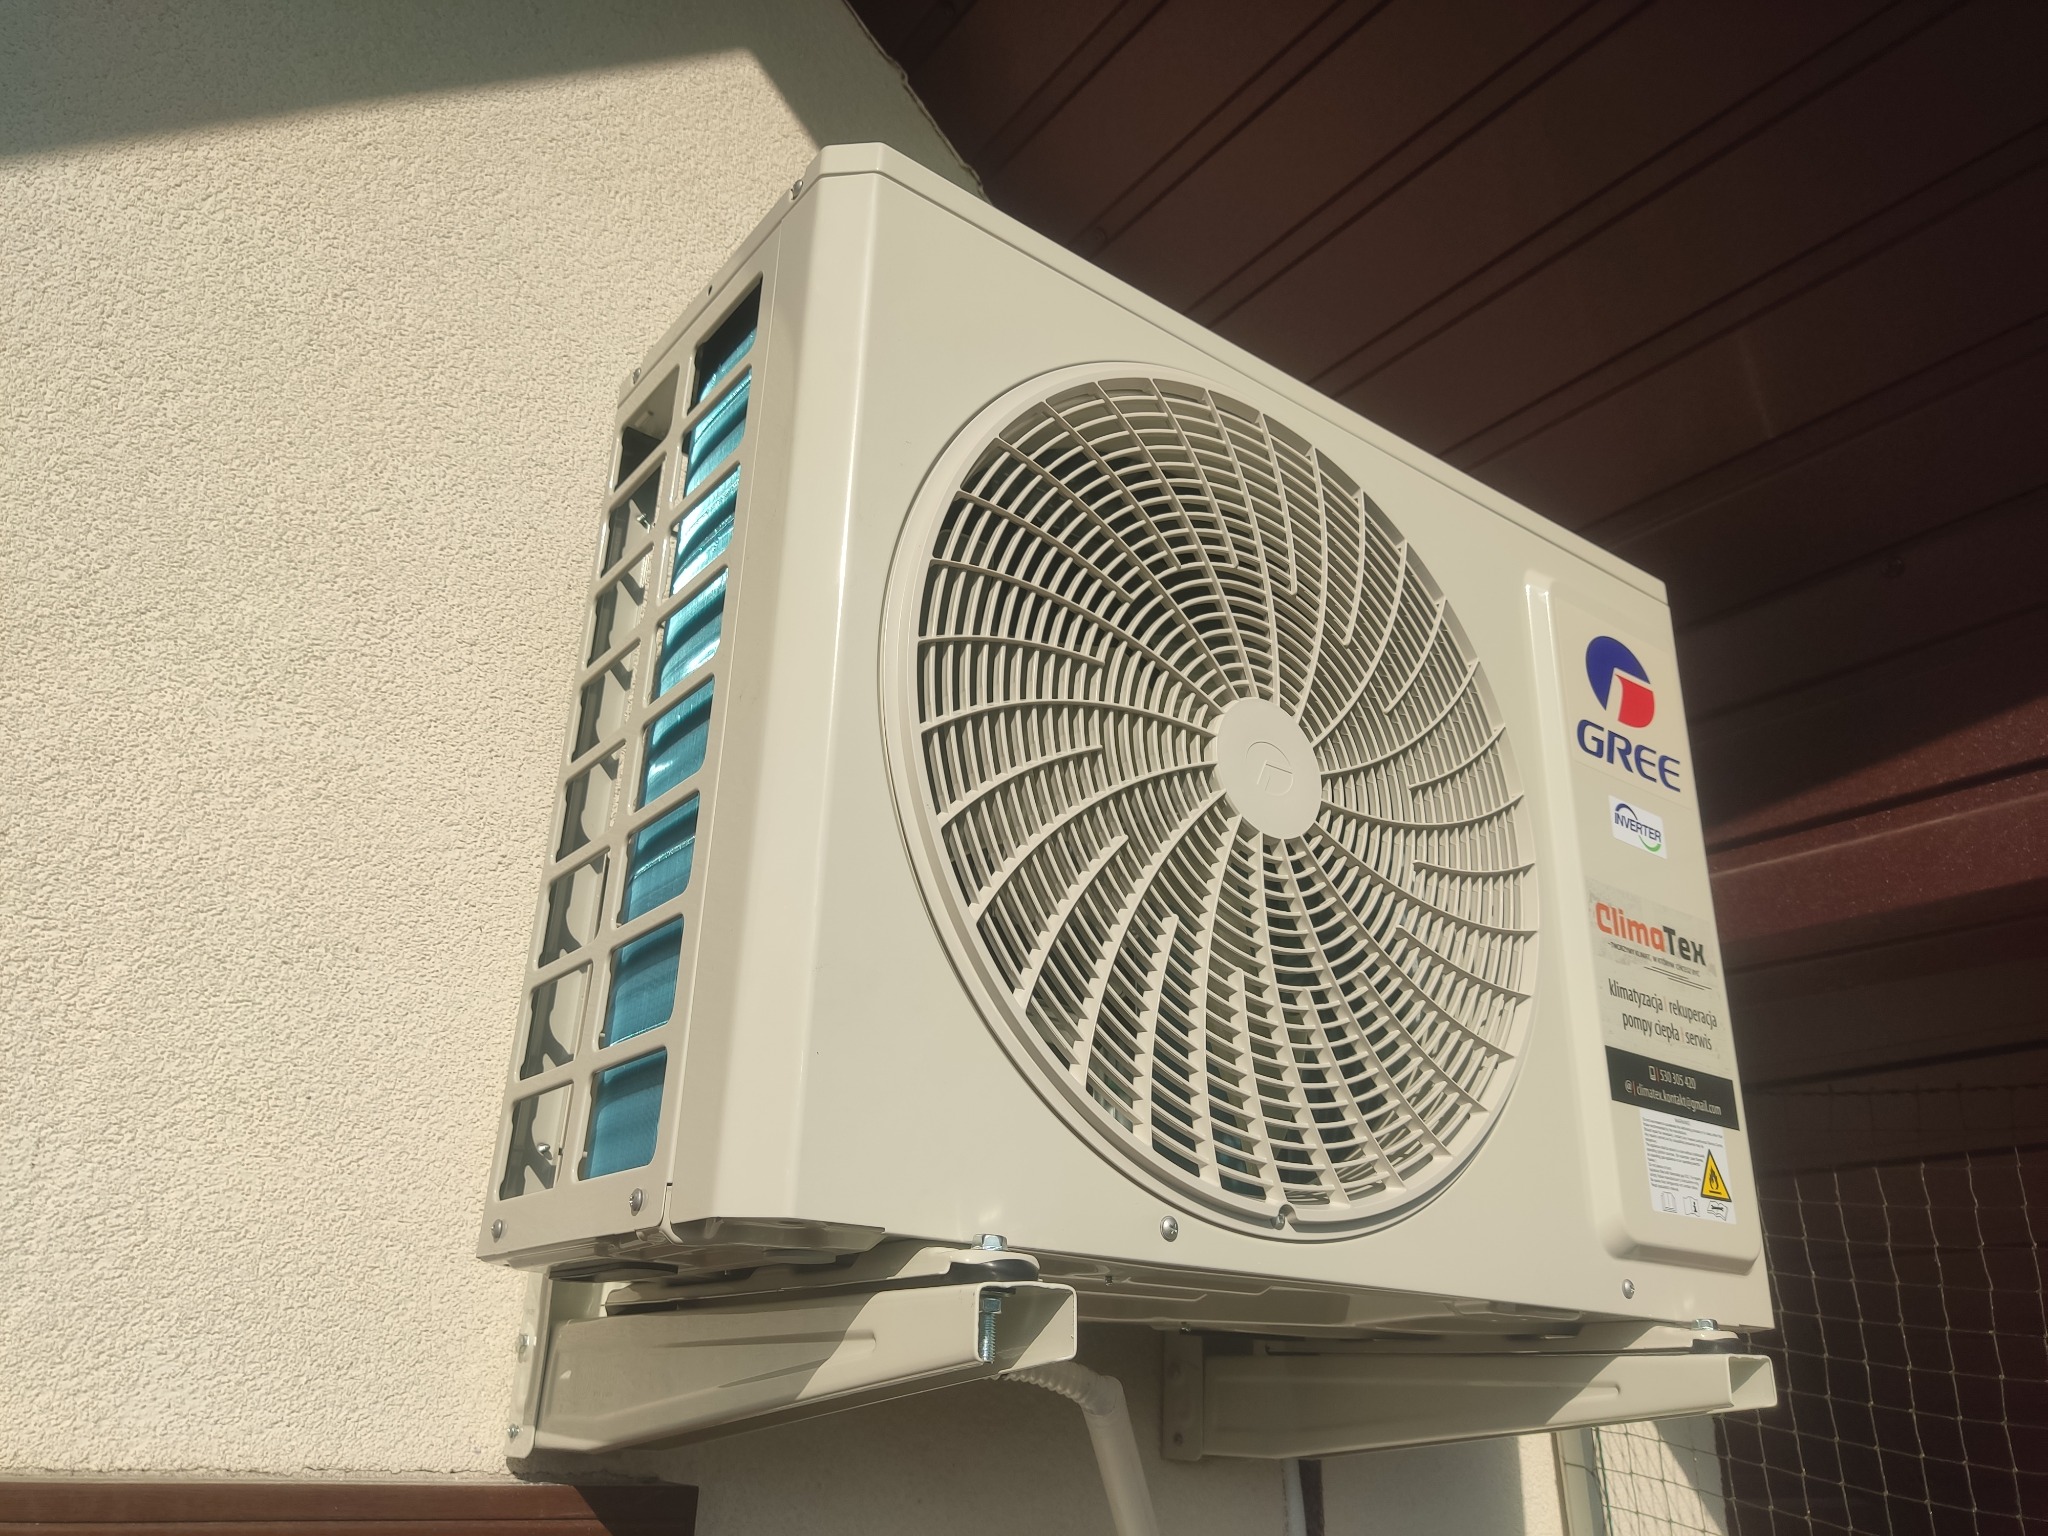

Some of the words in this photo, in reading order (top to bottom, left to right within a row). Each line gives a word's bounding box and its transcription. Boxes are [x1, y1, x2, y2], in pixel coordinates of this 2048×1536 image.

[1577, 719, 1681, 793] GREE
[1614, 812, 1662, 843] INVERTER
[1595, 900, 1707, 966] ClimaTex
[1608, 978, 1664, 1013] klimatyzacja
[1668, 999, 1718, 1030] rekuperacja
[1622, 1012, 1653, 1036] pompy
[1655, 1020, 1680, 1043] ciepła
[1684, 1032, 1712, 1050] serwis
